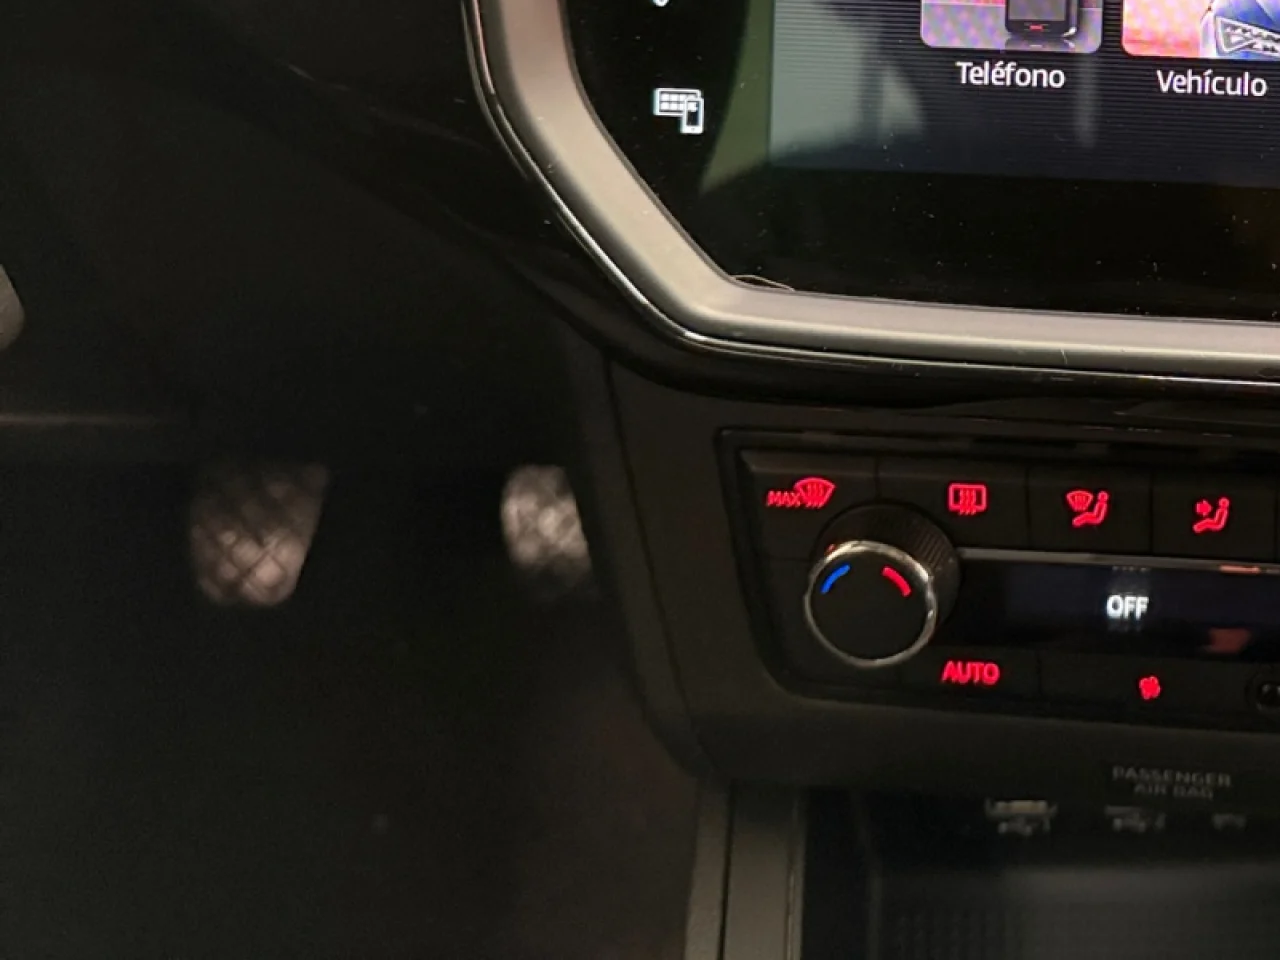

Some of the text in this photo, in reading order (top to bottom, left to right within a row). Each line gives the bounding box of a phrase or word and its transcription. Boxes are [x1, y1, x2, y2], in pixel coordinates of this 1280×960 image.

[956, 60, 1065, 88] Teléfono
[1156, 68, 1268, 97] Vehículo
[767, 490, 801, 508] MAX
[1106, 595, 1149, 619] OFF
[941, 660, 1001, 686] AUTO
[1112, 765, 1231, 787] PASSENGER
